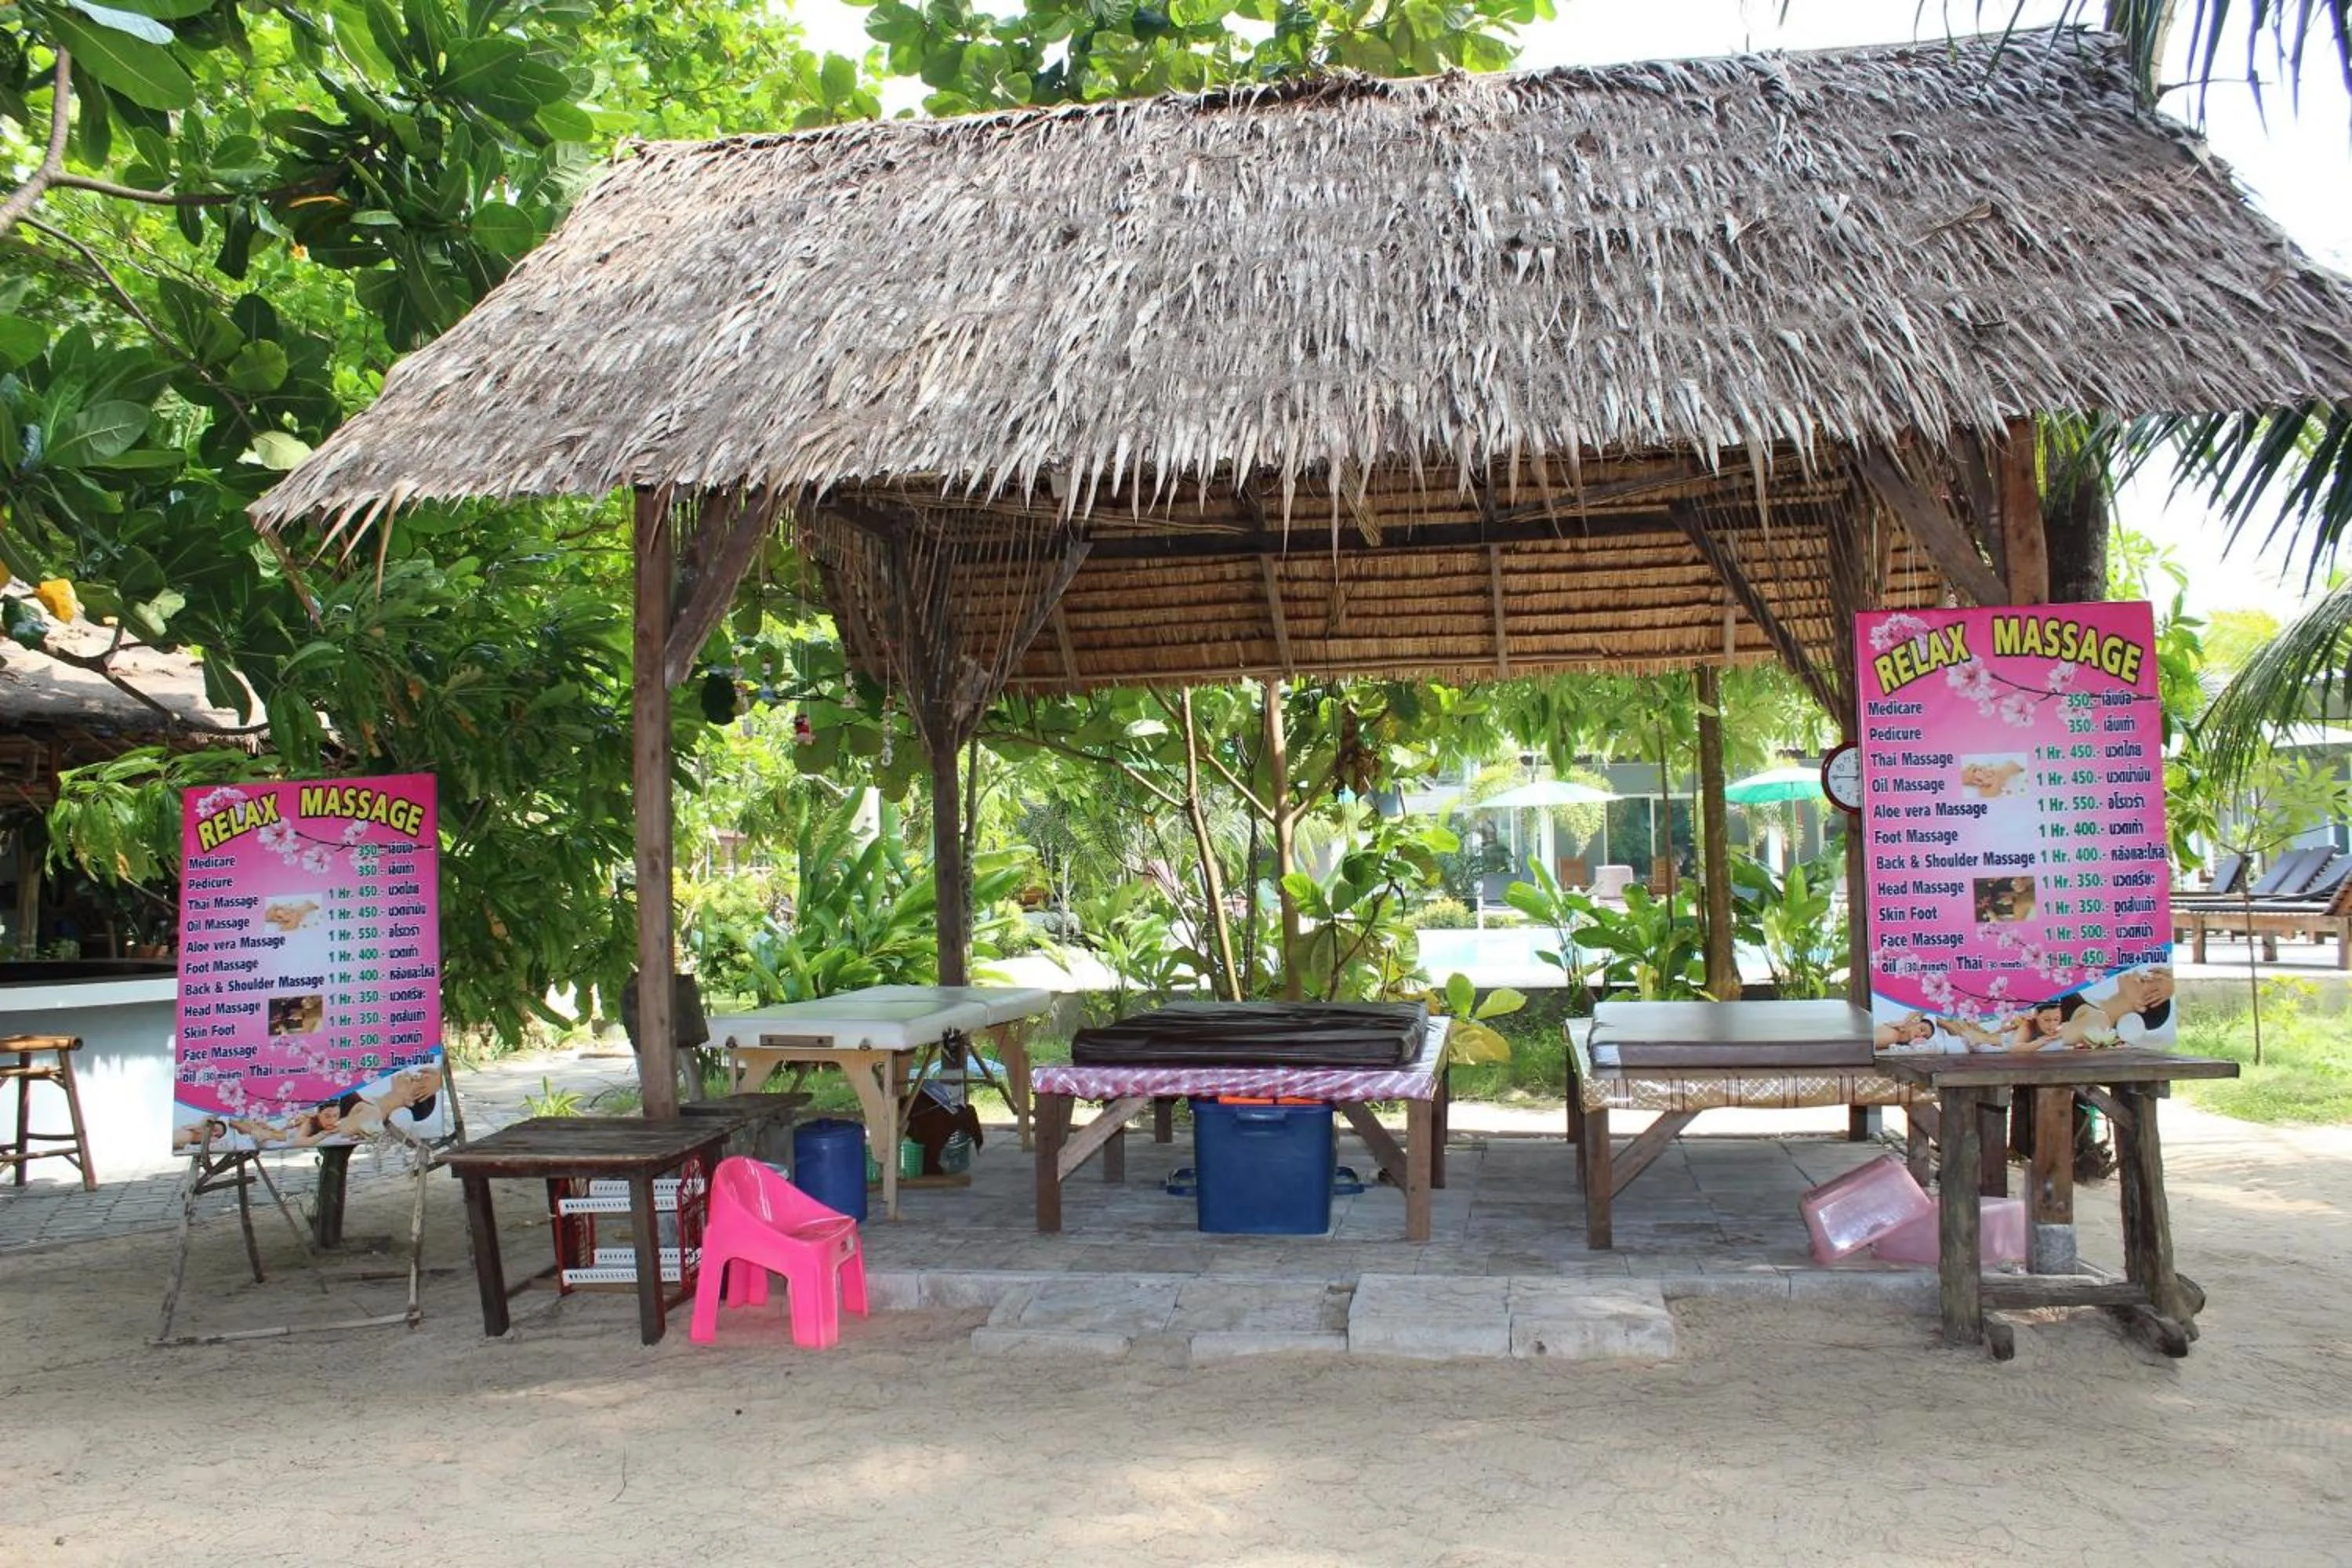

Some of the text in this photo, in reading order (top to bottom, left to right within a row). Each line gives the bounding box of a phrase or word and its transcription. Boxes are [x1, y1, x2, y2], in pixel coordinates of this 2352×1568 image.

[1874, 616, 2143, 696] RELAX MASSAGE
[2067, 693, 2097, 707] 350.-
[1868, 701, 1922, 715] Medicare
[2068, 719, 2098, 732] 350.-
[1869, 728, 1922, 740] Pedicure
[2035, 745, 2100, 759] 1 Hr. 450.-
[1871, 753, 1896, 766] Thai
[1901, 752, 1953, 768] Massage
[2037, 771, 2102, 785] 1 Hr. 450.-
[1872, 778, 1944, 794] Oil Massage
[1874, 803, 1987, 818] Aloe vera Massage
[2038, 797, 2103, 812] 1 Hr. 550.-
[198, 786, 425, 853] RELAX MASSAGE
[2039, 822, 2104, 837] 1 Hr. 400.-
[1875, 829, 1958, 845] Foot Massage
[359, 845, 384, 855] 350.-
[2042, 848, 2106, 862] 1 Hr. 400.-
[189, 856, 235, 869] Medicare
[1877, 851, 2035, 869] Back & Shoulder Massage
[358, 866, 384, 877] 350.-
[188, 877, 233, 890] Pedicure
[1878, 880, 1964, 896] Head Massage
[2043, 873, 2107, 889] 1 Hr. 350.-
[329, 886, 384, 898] 1 Hr. 450.-
[188, 896, 258, 910] Thai Massage
[2045, 899, 2109, 914] 1 Hr. 350.-
[328, 907, 385, 920] 1 Hr. 450.-
[1879, 906, 1937, 920] Skin Foot
[187, 918, 250, 932] Oil Massage
[329, 928, 385, 941] 1 Hr. 550.-
[2045, 925, 2111, 940] 1 Hr. 500.-
[186, 936, 285, 953] Aloe vera Massage
[1880, 933, 1964, 948] Face Massage
[329, 949, 385, 962] 1 Hr. 400.-
[2047, 950, 2112, 966] 1 Hr. 450.-
[186, 960, 259, 975] Foot Massage
[1882, 959, 1896, 972] oil
[1955, 955, 1982, 969] Thai
[329, 969, 385, 983] 1 Hr. 400.-
[185, 975, 325, 996] Back & Shoulder Massage
[329, 991, 386, 1005] 1 Hr. 350.-
[184, 1002, 261, 1017] Head Massage
[330, 1013, 386, 1026] 1 Hr. 350.-
[183, 1024, 235, 1039] Skin Foot
[330, 1034, 386, 1047] 1 Hr. 500.-
[183, 1046, 258, 1060] Face Massage
[329, 1055, 386, 1069] 1 Hr. 450.-
[183, 1070, 195, 1082] oil
[249, 1063, 272, 1076] Thai
